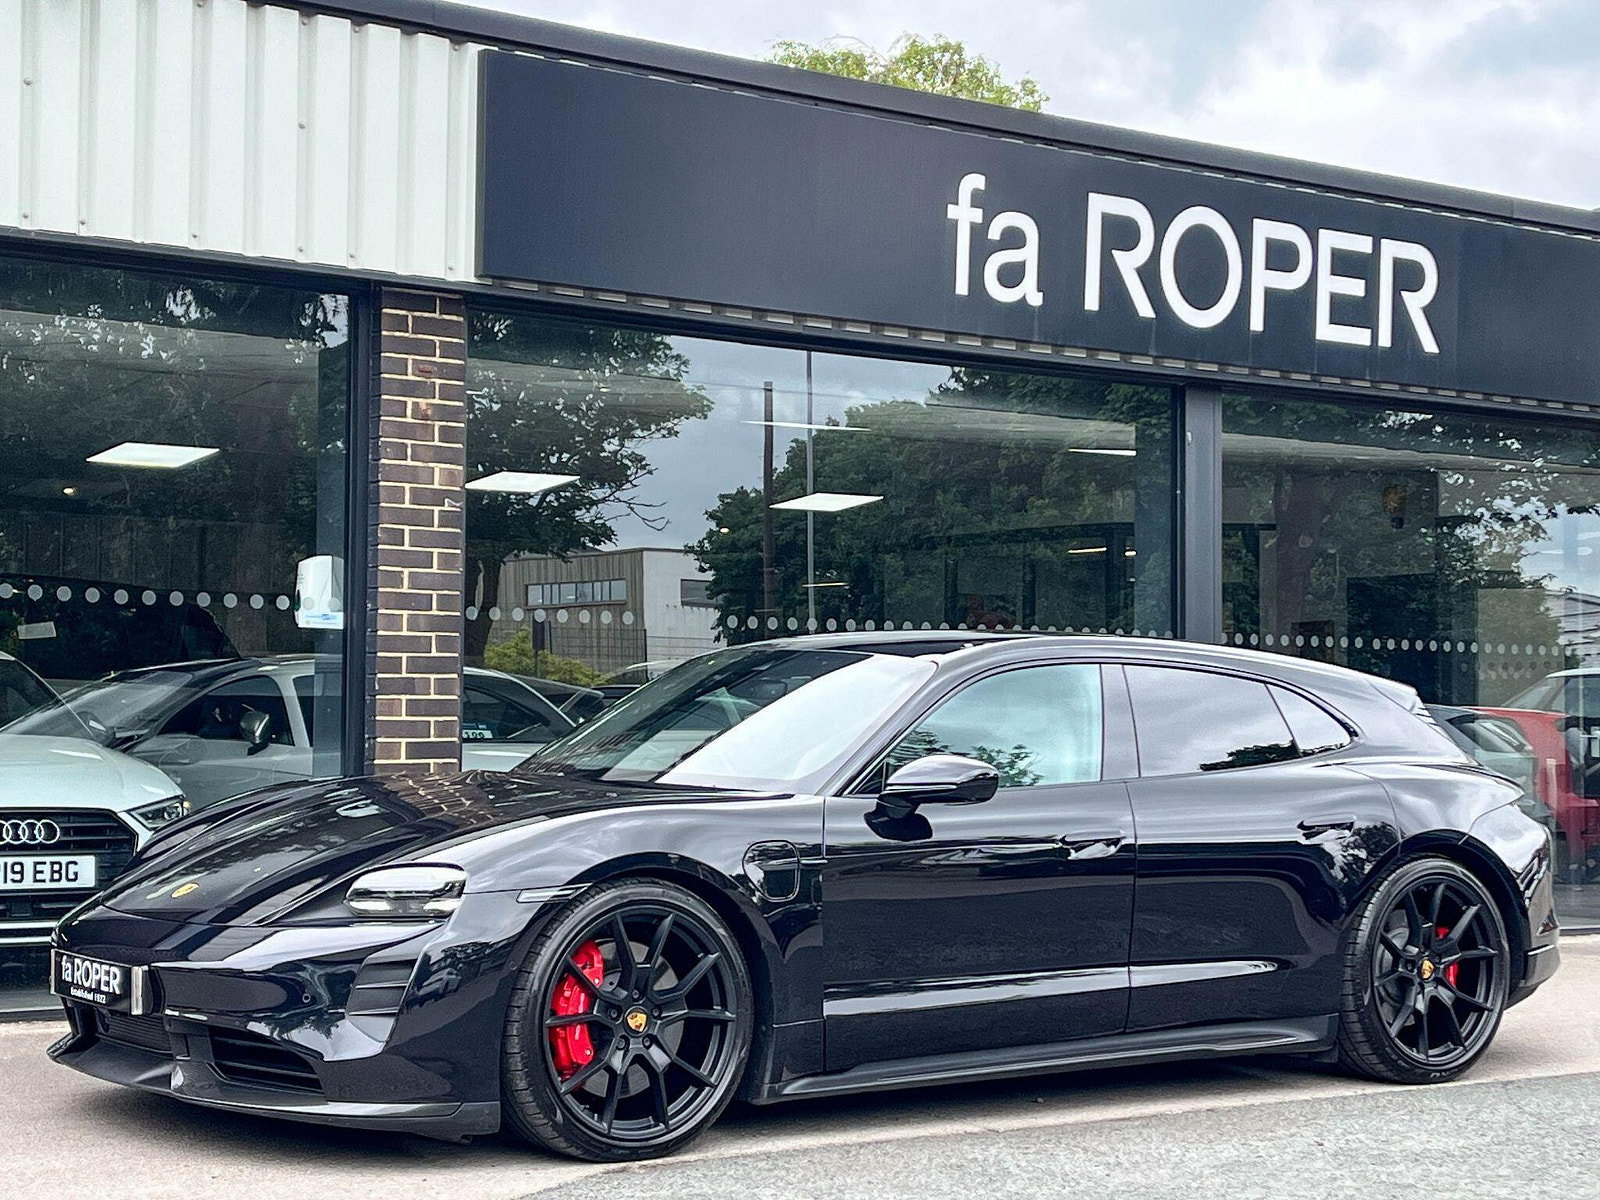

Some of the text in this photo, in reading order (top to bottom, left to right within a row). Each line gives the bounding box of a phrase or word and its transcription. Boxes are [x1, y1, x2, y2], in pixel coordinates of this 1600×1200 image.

[946, 172, 1440, 353] fa ROPER
[0, 861, 79, 884] 19 EBG
[61, 954, 121, 995] fa ROPER
